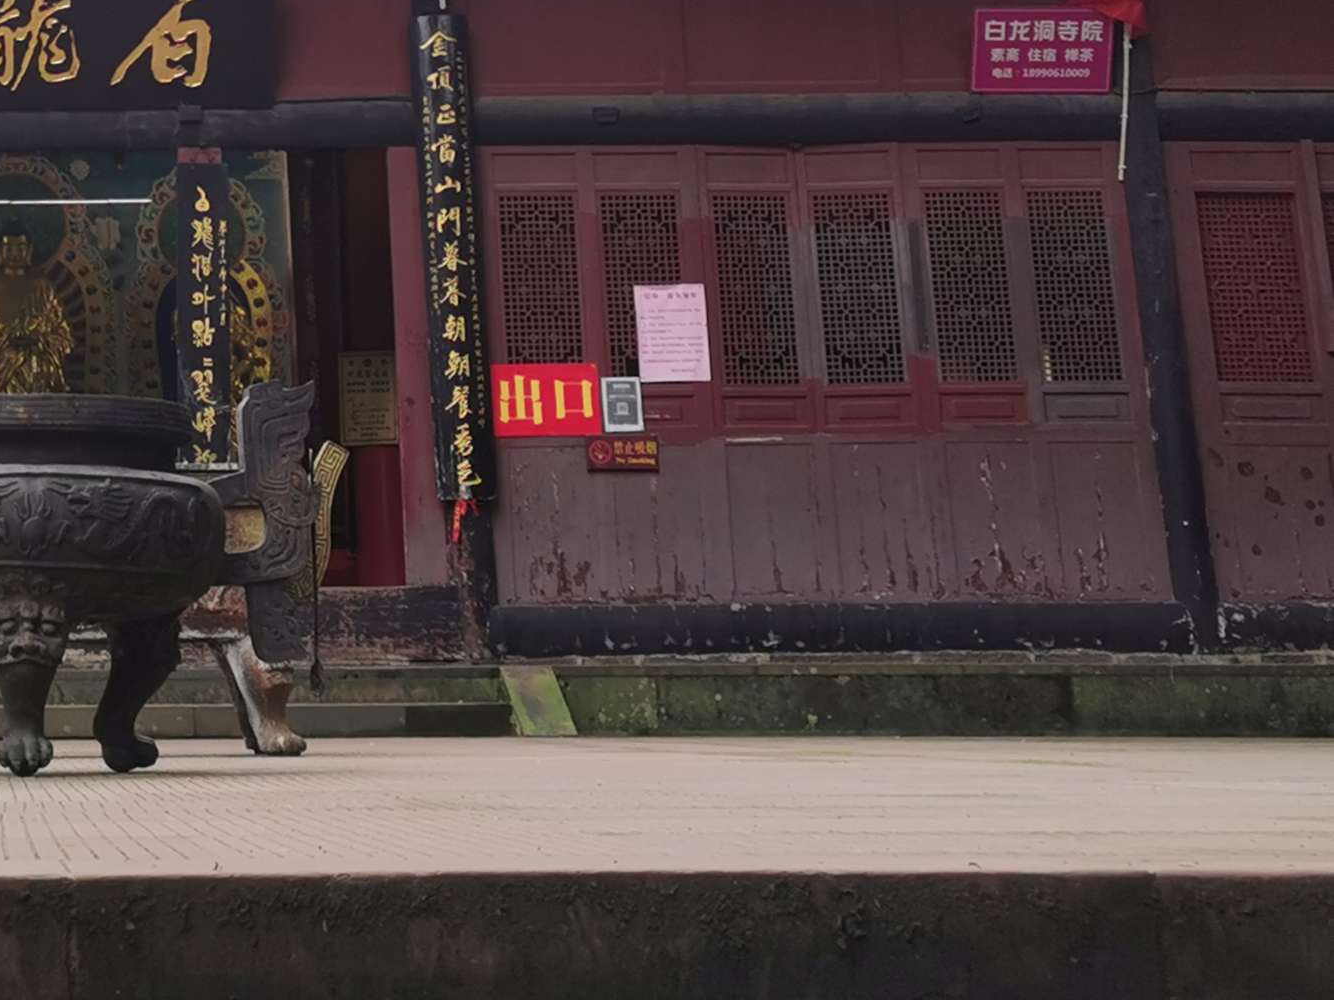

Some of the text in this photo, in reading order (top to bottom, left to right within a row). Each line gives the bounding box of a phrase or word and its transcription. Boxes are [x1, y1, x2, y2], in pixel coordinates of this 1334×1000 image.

[984, 19, 1104, 42] 白龙洞寺院
[1027, 47, 1057, 62] 住宿
[1064, 47, 1094, 62] 禅茶
[499, 374, 594, 426] 出口
